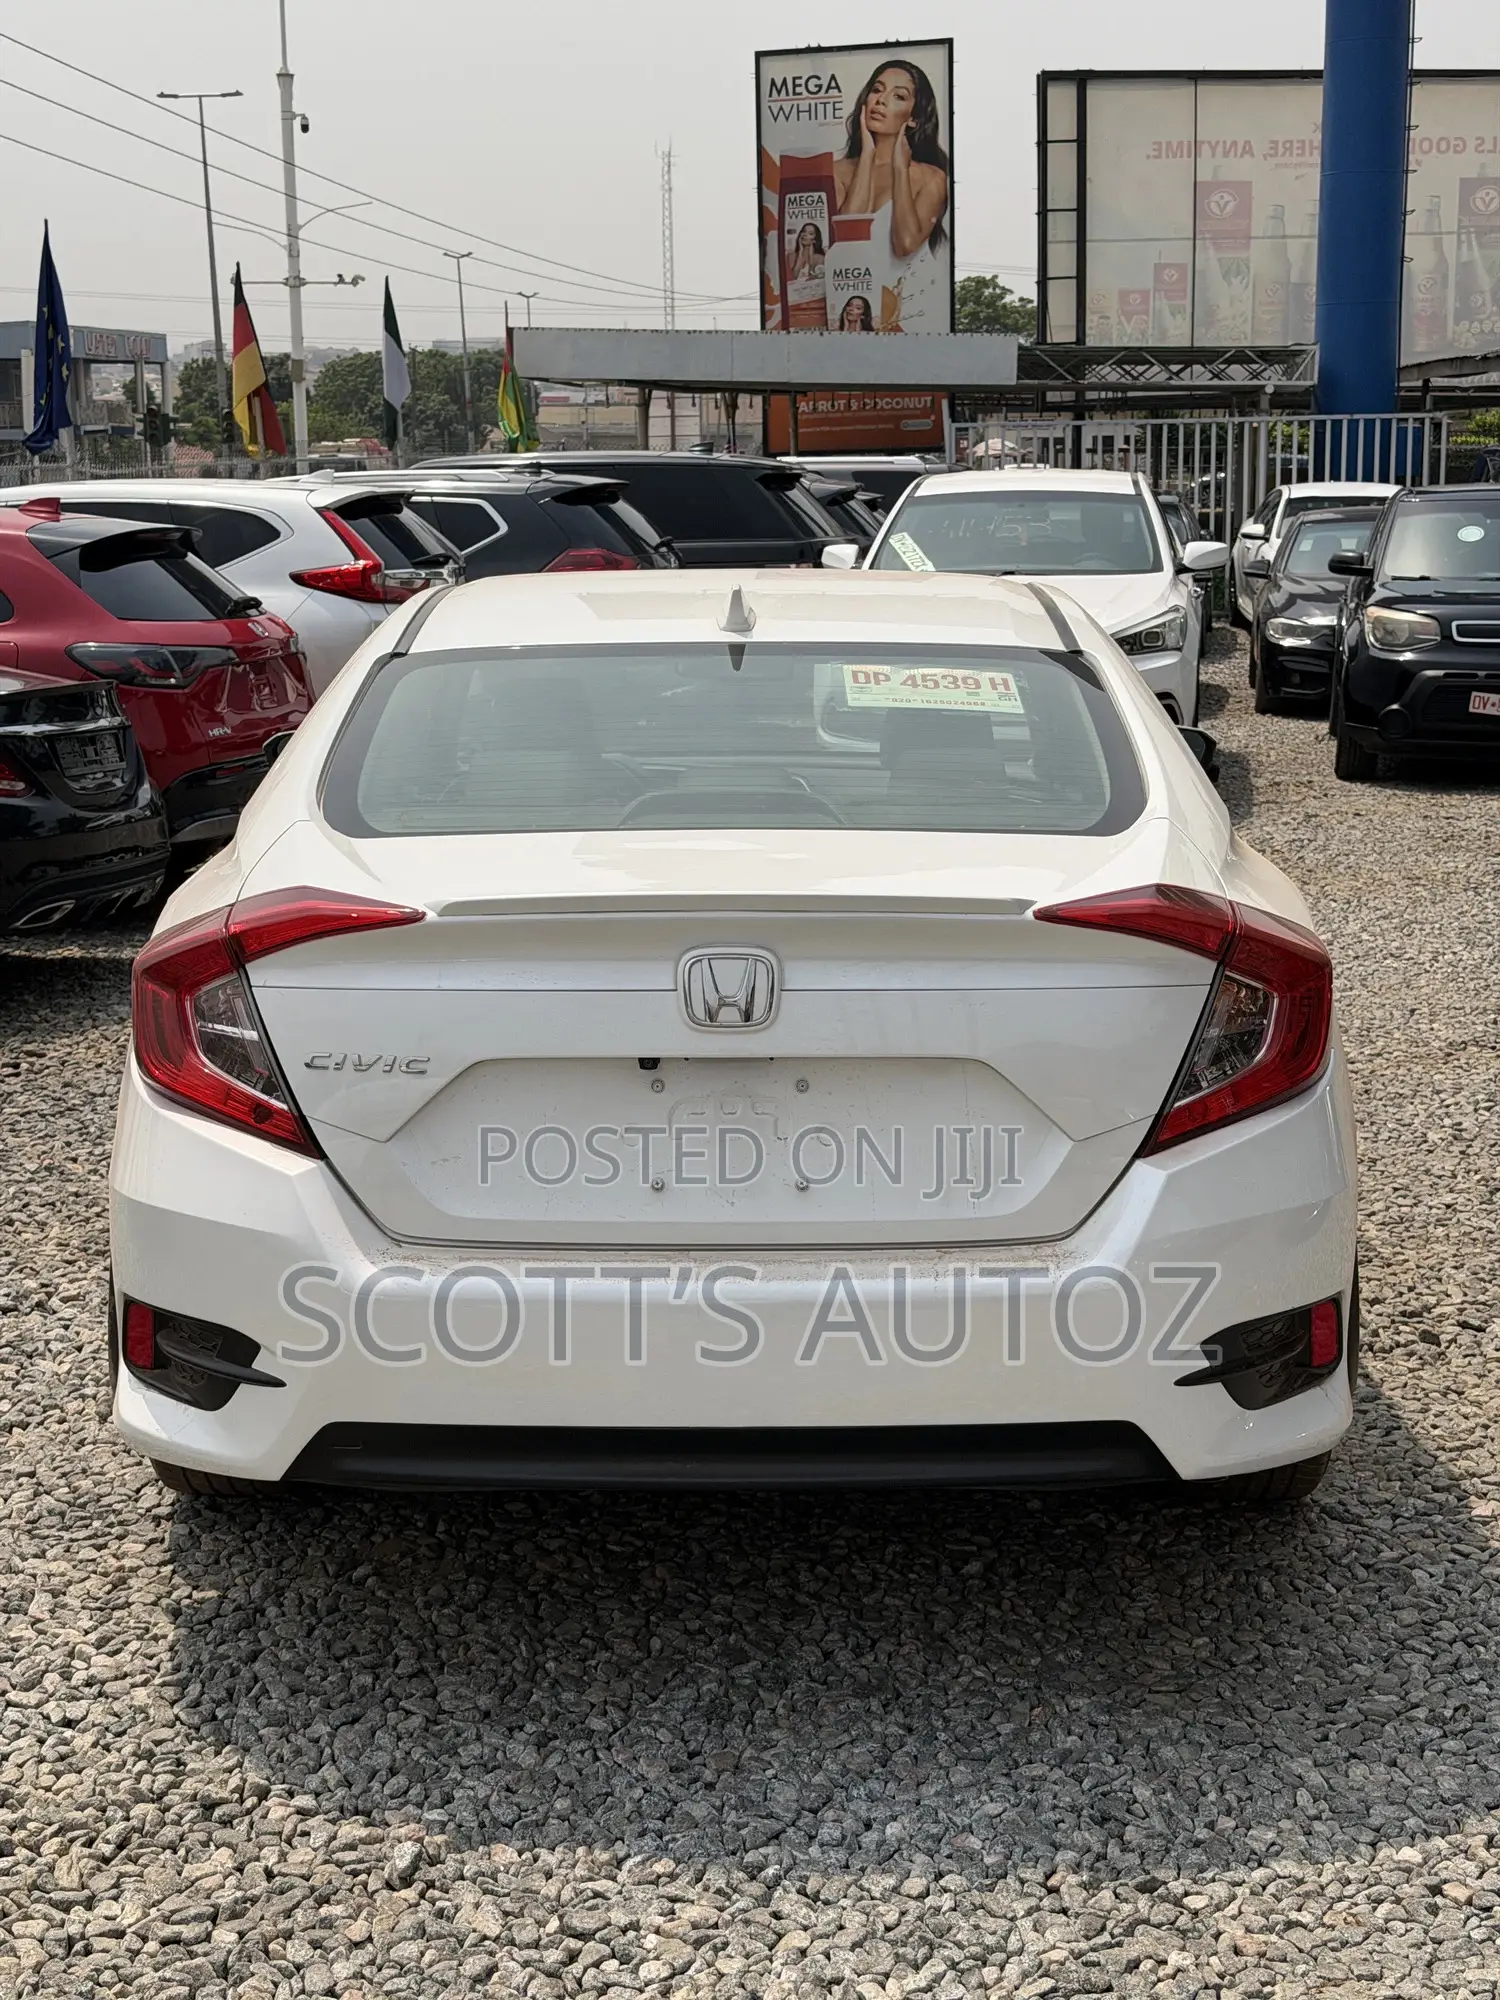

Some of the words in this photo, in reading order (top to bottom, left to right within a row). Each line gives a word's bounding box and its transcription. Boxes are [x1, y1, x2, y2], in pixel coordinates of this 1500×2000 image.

[768, 73, 842, 98] MEGA
[768, 101, 843, 123] WHITE
[787, 194, 825, 207] MEGA
[787, 208, 826, 220] WHITE
[832, 267, 872, 279] MEGA
[832, 281, 872, 291] WHITE
[851, 669, 892, 686] DP
[900, 673, 982, 690] 4539
[989, 677, 1012, 692] H
[208, 726, 231, 738] HR-V
[303, 1052, 430, 1075] CIVIC
